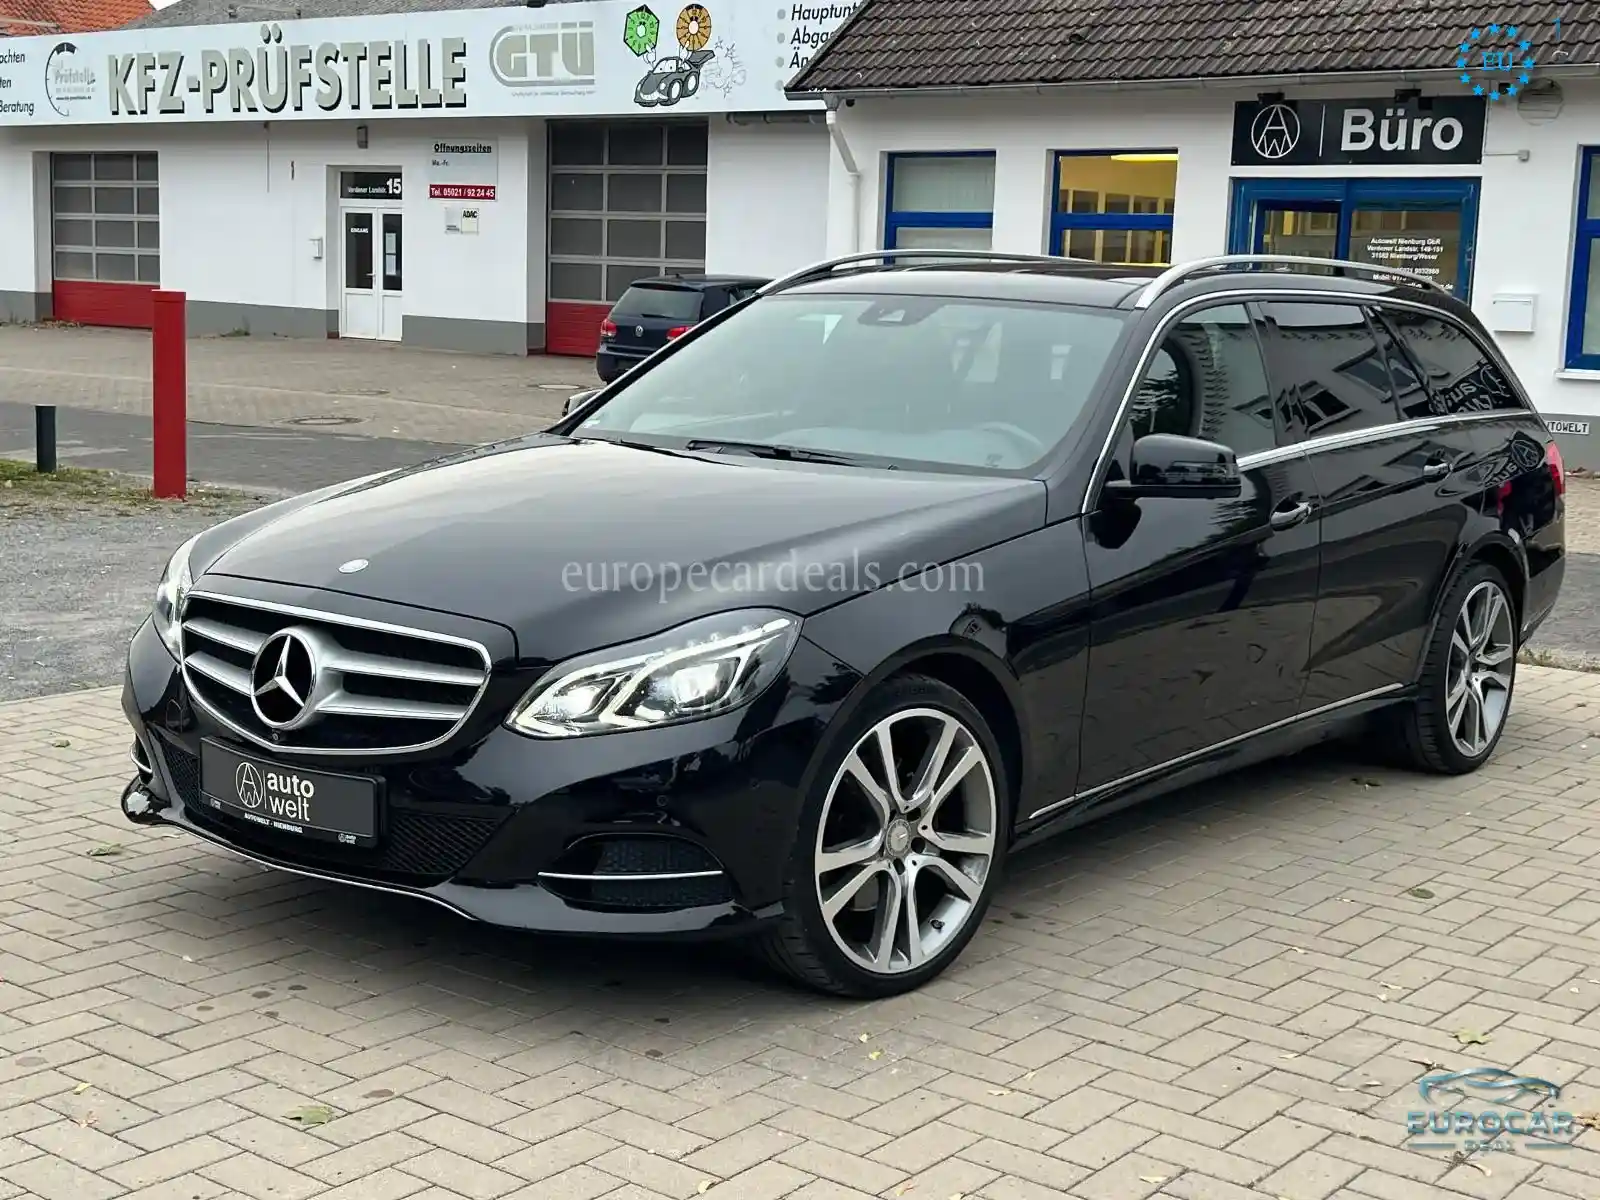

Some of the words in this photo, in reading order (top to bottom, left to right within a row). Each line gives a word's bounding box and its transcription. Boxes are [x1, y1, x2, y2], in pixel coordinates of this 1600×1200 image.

[107, 24, 467, 115] KFZ-PRÜFSTELLE
[1340, 107, 1463, 151] Büro
[267, 772, 314, 798] auto
[269, 796, 310, 822] welt
